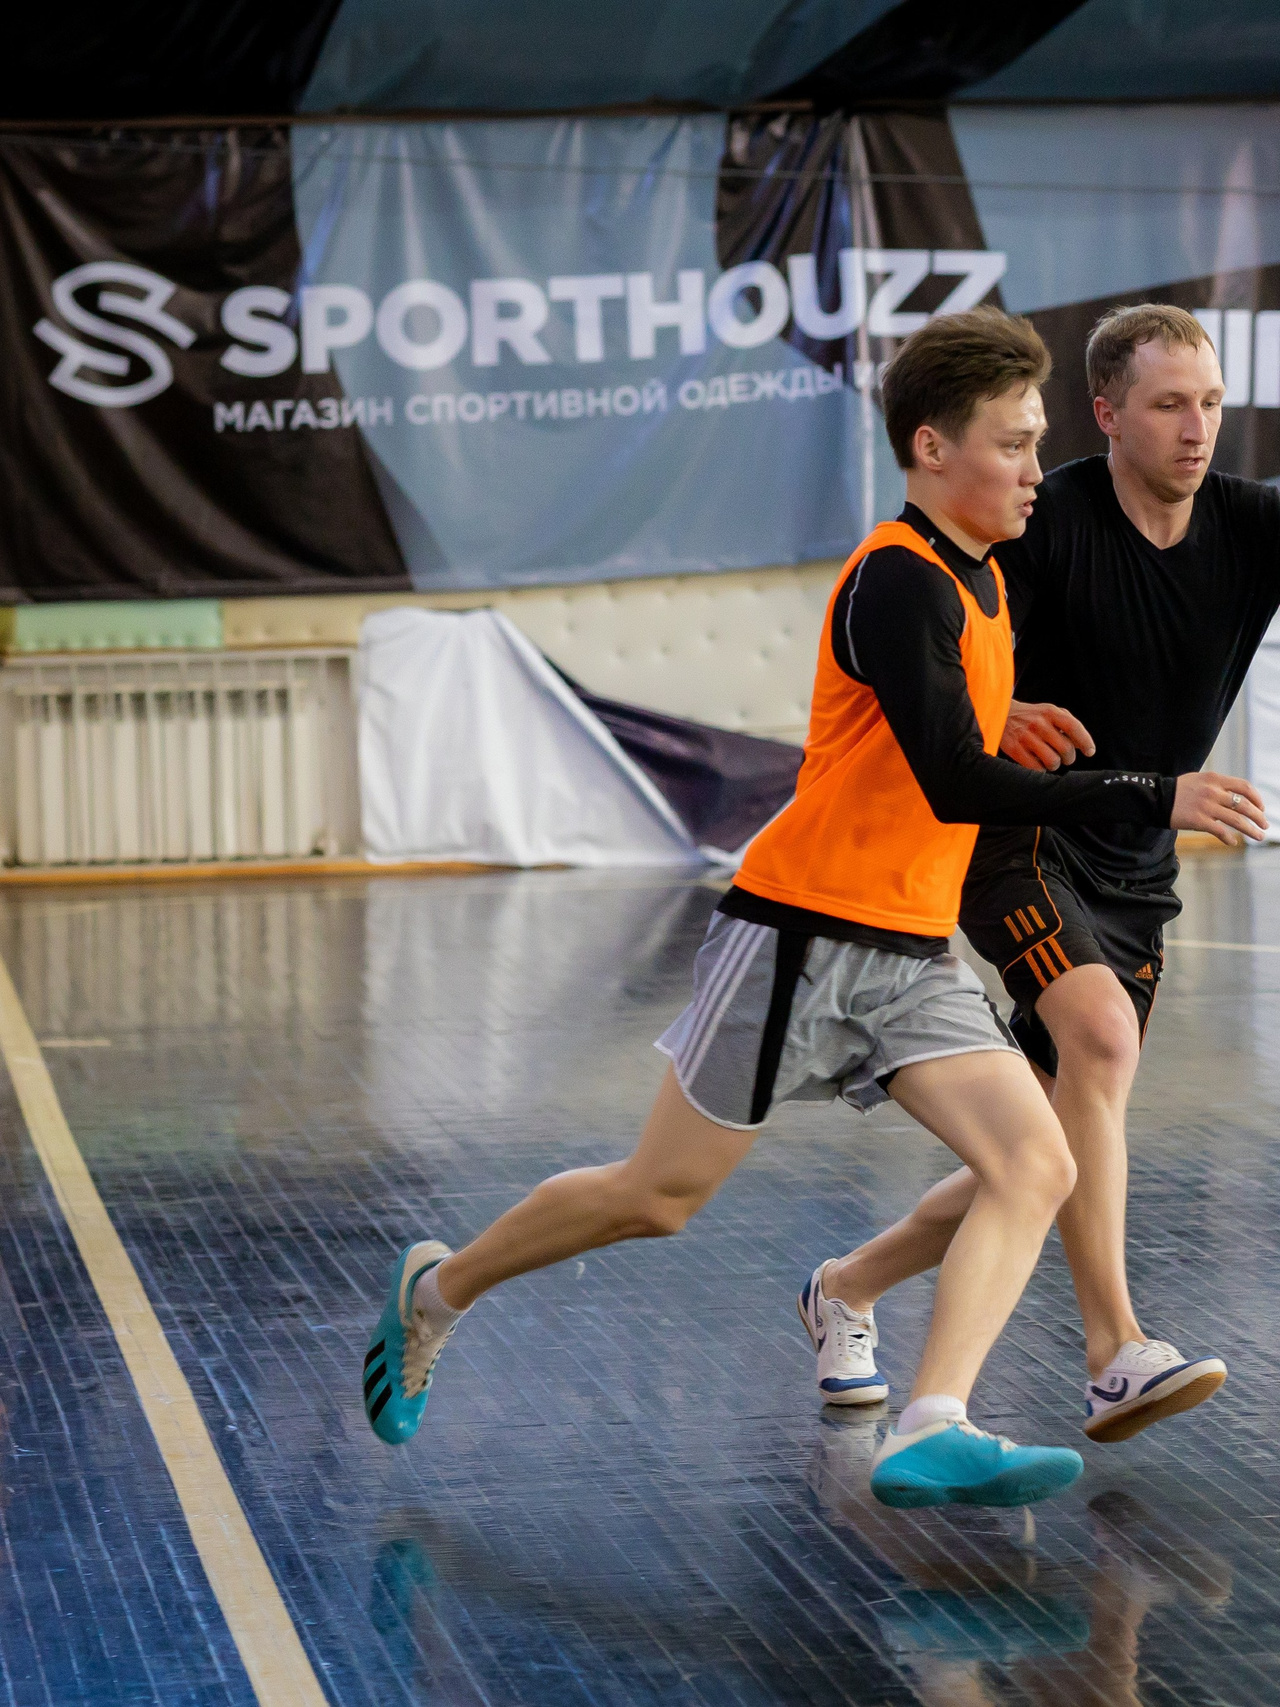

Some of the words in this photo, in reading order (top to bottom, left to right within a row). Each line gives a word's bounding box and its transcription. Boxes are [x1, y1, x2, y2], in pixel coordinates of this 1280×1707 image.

[219, 248, 1007, 378] SPORTHOUZZ
[213, 396, 394, 433] МАГАЗИН
[405, 377, 668, 425] СПОРТИВНОЙ
[679, 361, 843, 410] ОДЕЖДЫ
